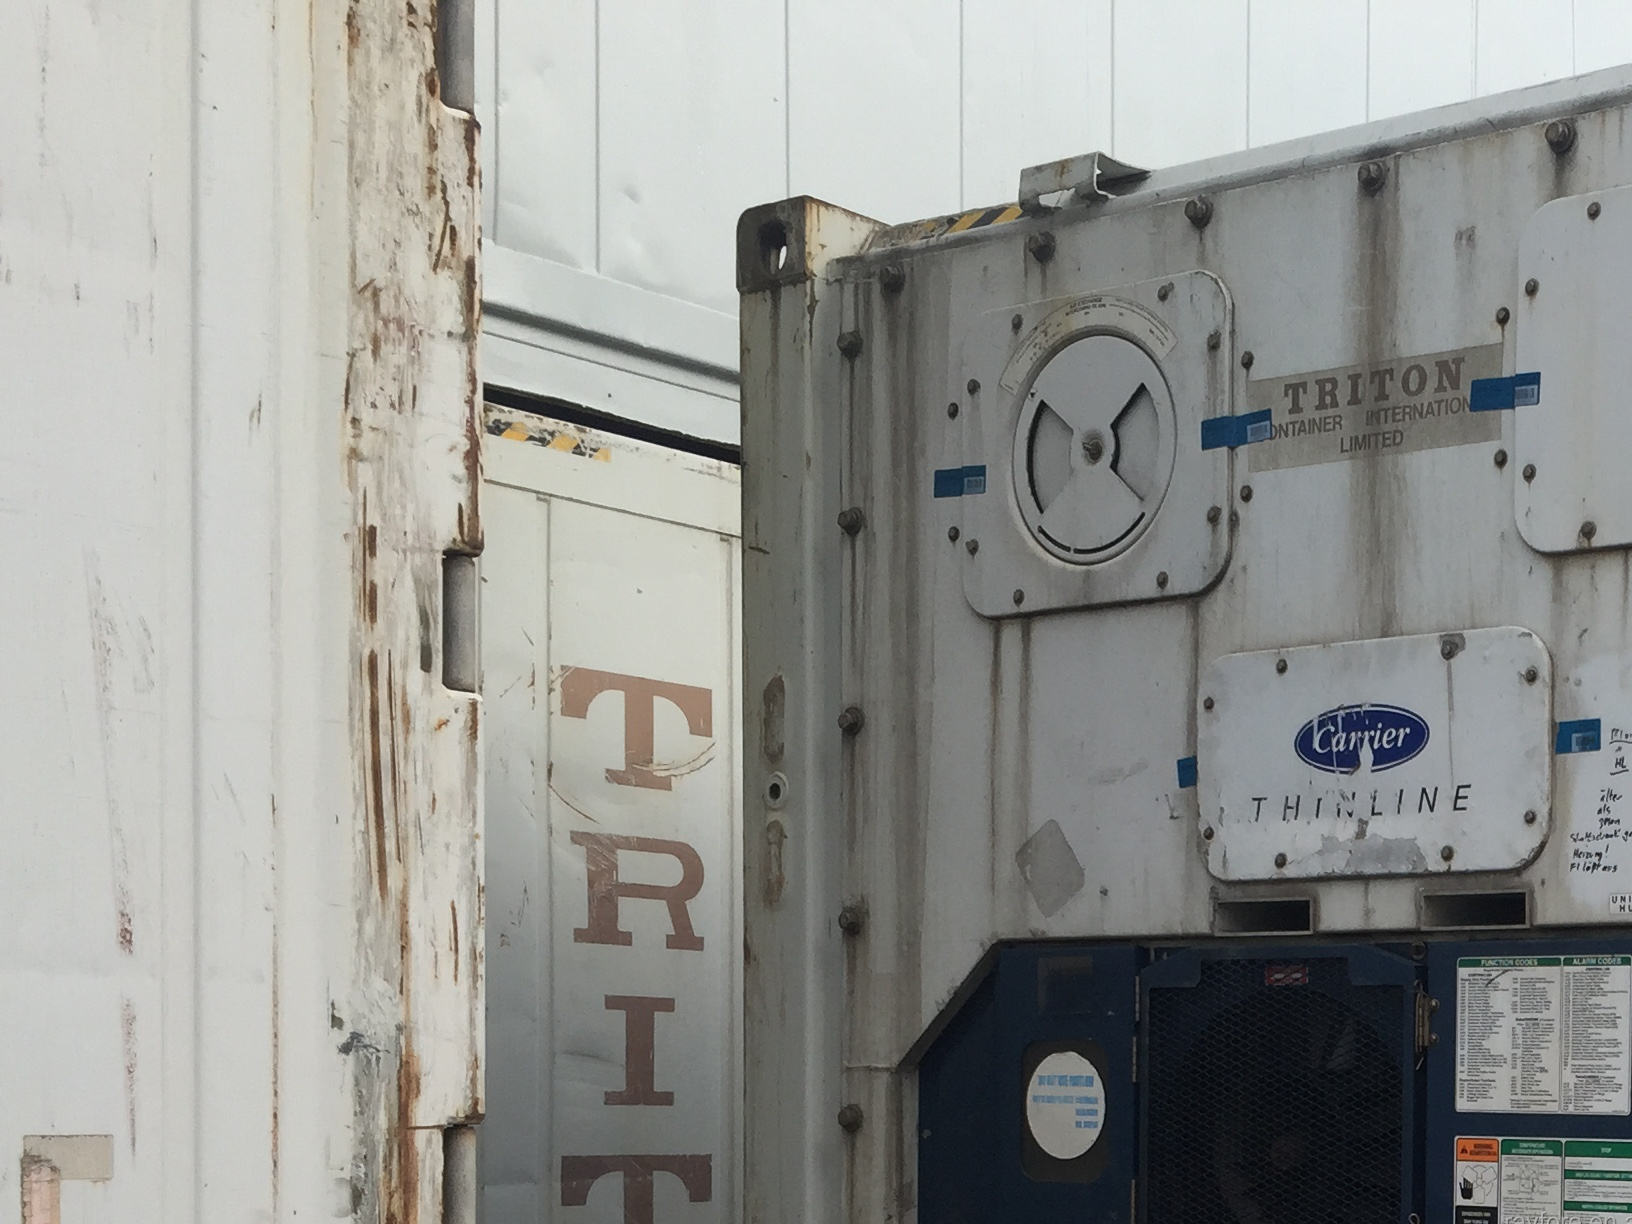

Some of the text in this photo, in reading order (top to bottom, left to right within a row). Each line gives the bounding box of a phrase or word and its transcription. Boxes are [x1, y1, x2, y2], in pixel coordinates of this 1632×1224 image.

[1283, 356, 1466, 415] TRITON
[1269, 396, 1472, 441] ONTAINER INTERNATION
[1340, 430, 1404, 454] LIMITED
[1313, 722, 1412, 755] Carrier
[1250, 783, 1473, 823] THINLINE
[1481, 958, 1538, 967] FUNCTION CODES
[1572, 957, 1622, 965] ALARM CODES
